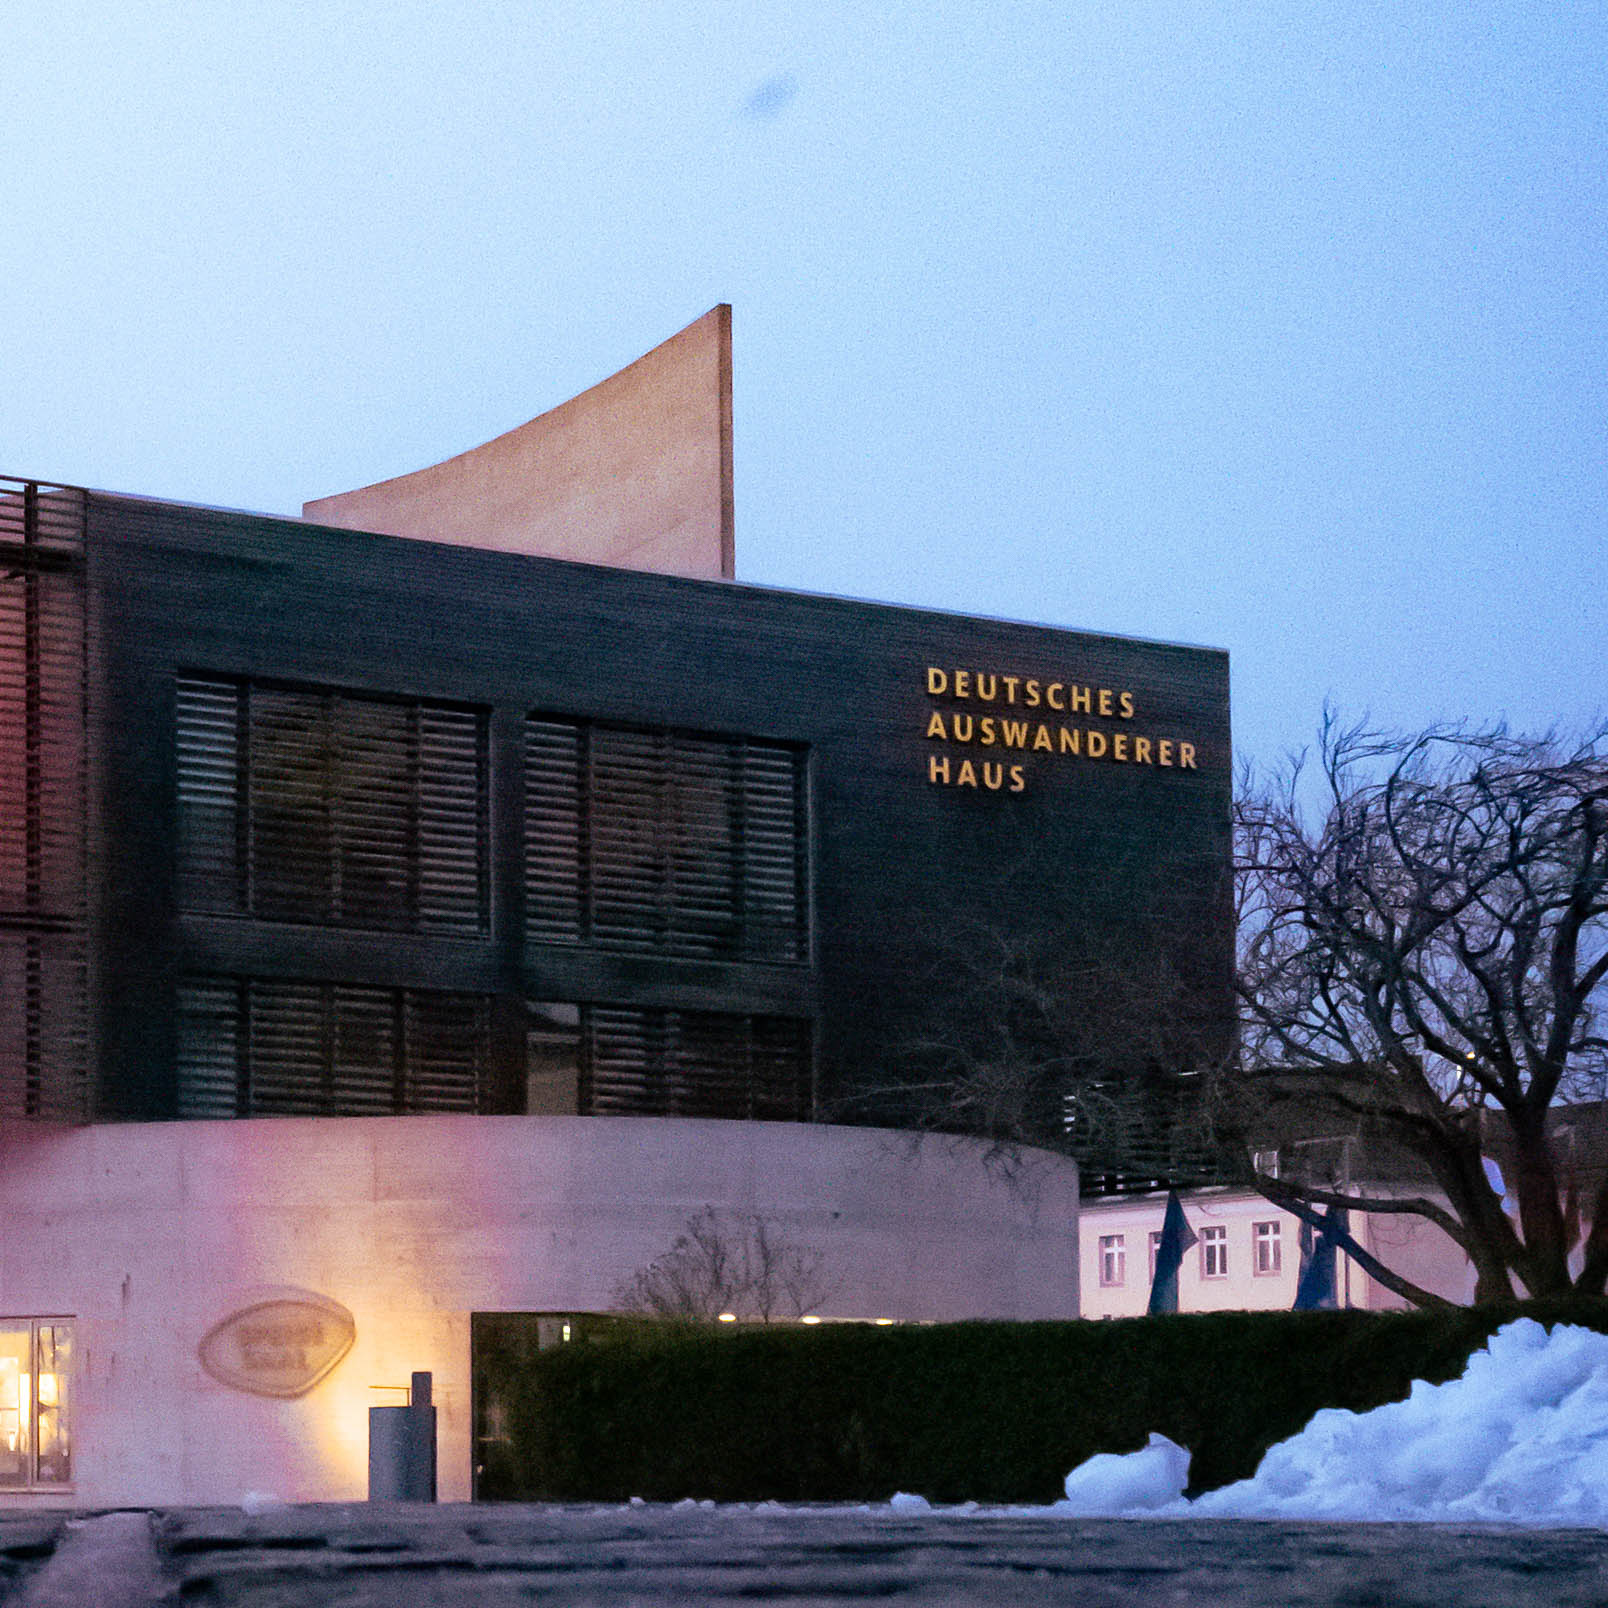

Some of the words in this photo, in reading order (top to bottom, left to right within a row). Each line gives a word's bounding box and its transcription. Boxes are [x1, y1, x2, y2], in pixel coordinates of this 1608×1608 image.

[927, 666, 1135, 719] DEUTSCHES
[927, 711, 1198, 769] AUSWANDERER
[929, 755, 1026, 793] HAUS
